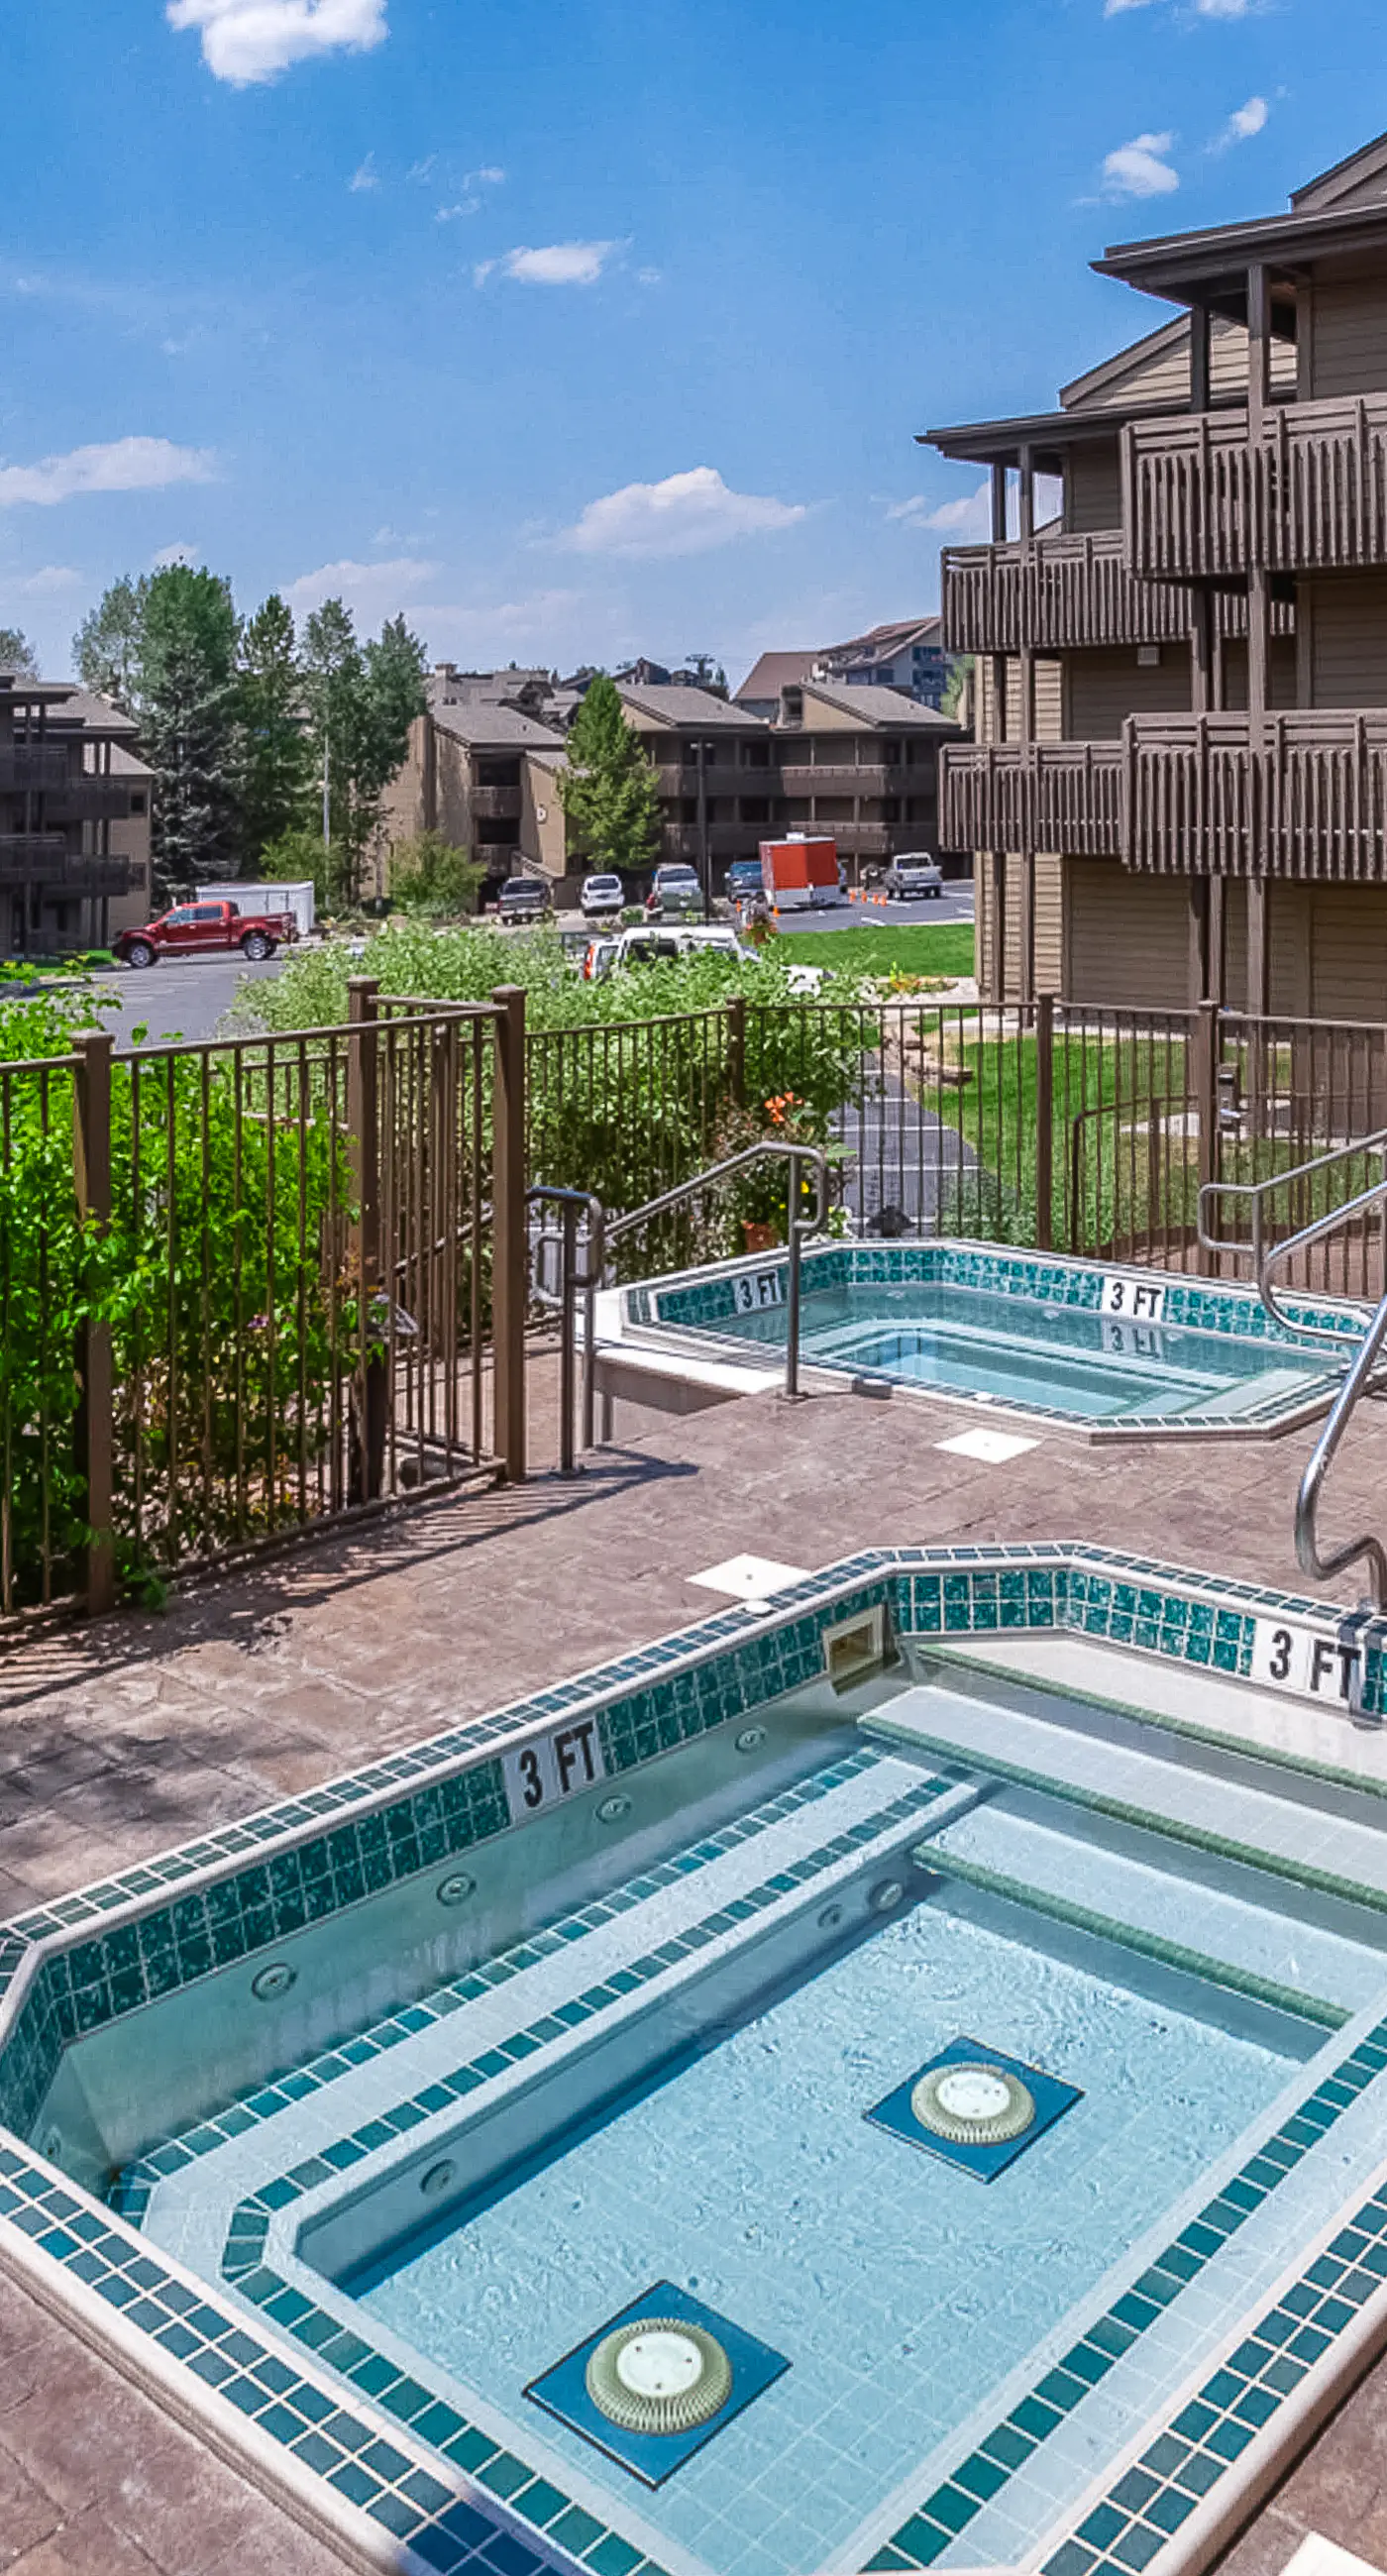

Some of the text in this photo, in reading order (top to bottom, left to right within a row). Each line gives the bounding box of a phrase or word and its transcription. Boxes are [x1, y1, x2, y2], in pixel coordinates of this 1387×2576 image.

[740, 1271, 776, 1308] 3 FT
[1111, 1281, 1162, 1318] 3 FT
[1269, 1628, 1362, 1701] 3 FT
[519, 1720, 594, 1808] 3 FT
